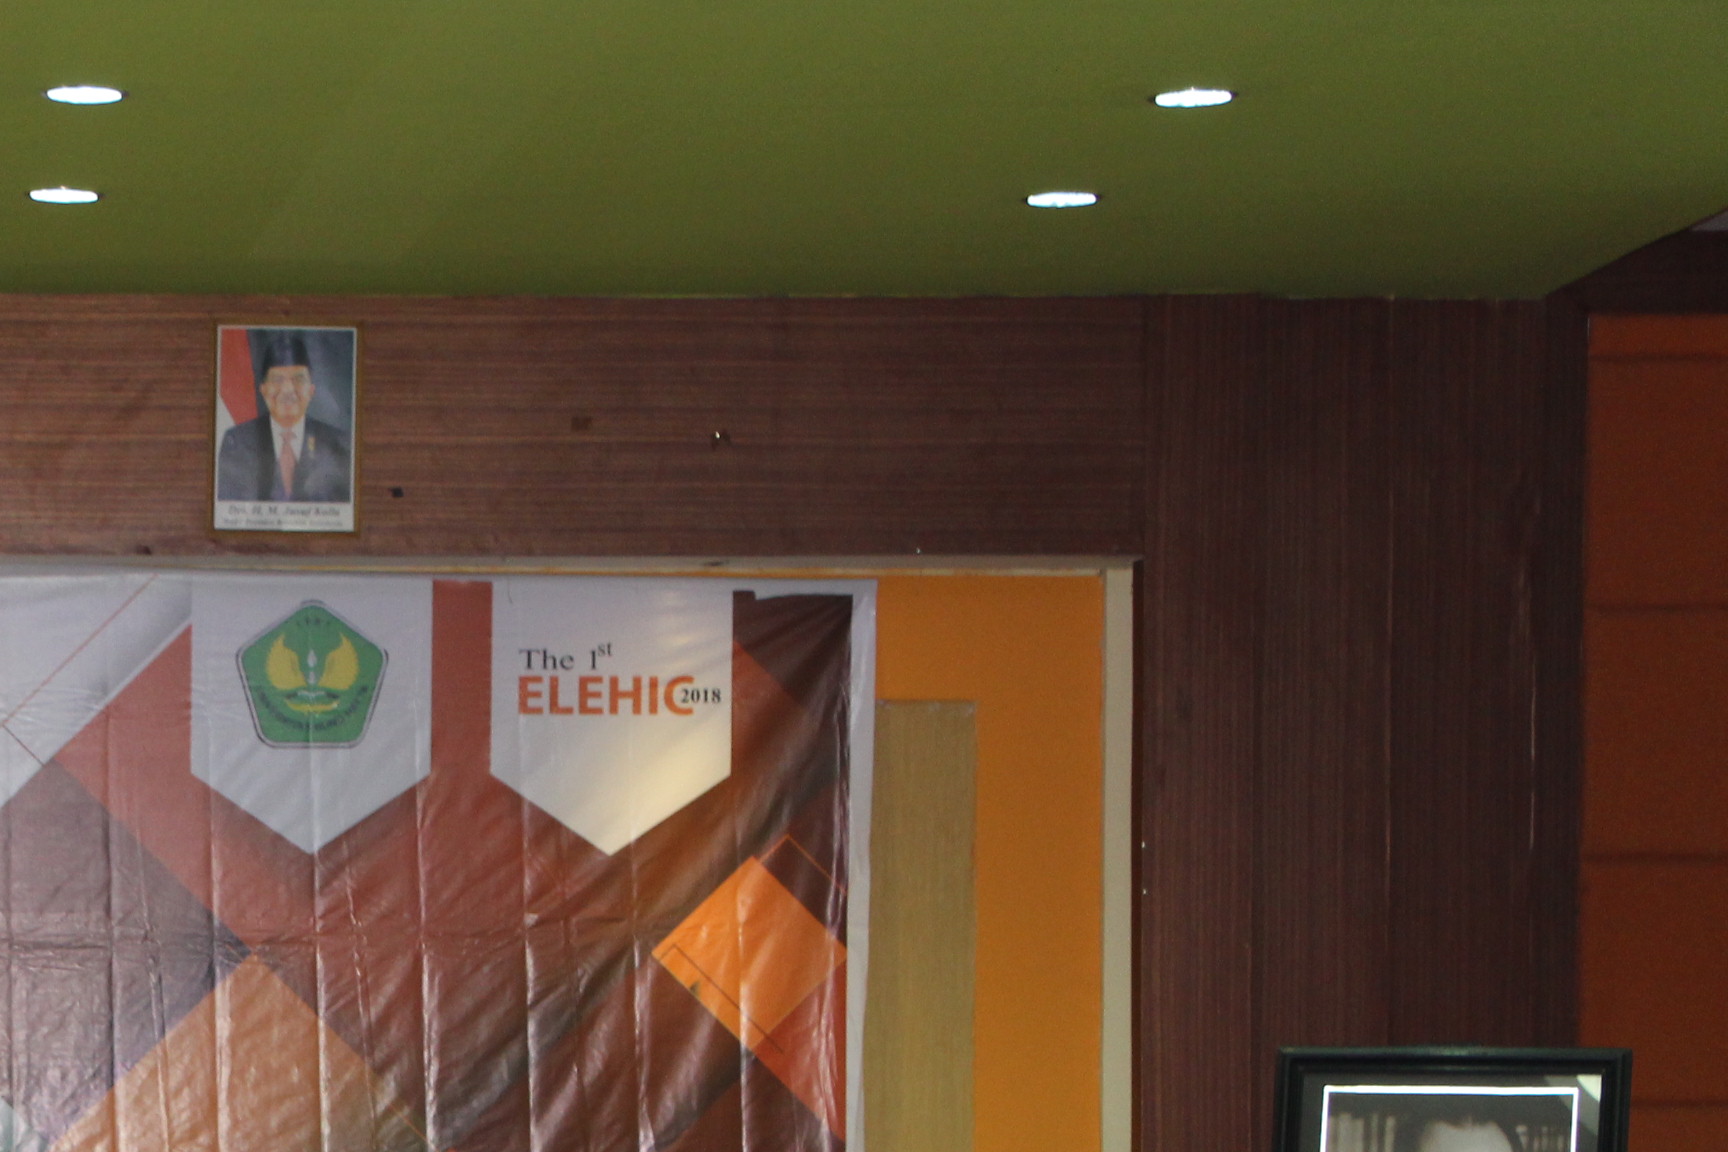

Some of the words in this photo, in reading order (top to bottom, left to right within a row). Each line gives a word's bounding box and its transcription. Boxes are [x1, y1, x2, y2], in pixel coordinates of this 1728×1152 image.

[519, 648, 574, 670] The
[518, 675, 695, 716] ELEHIC
[680, 687, 721, 704] 2018
